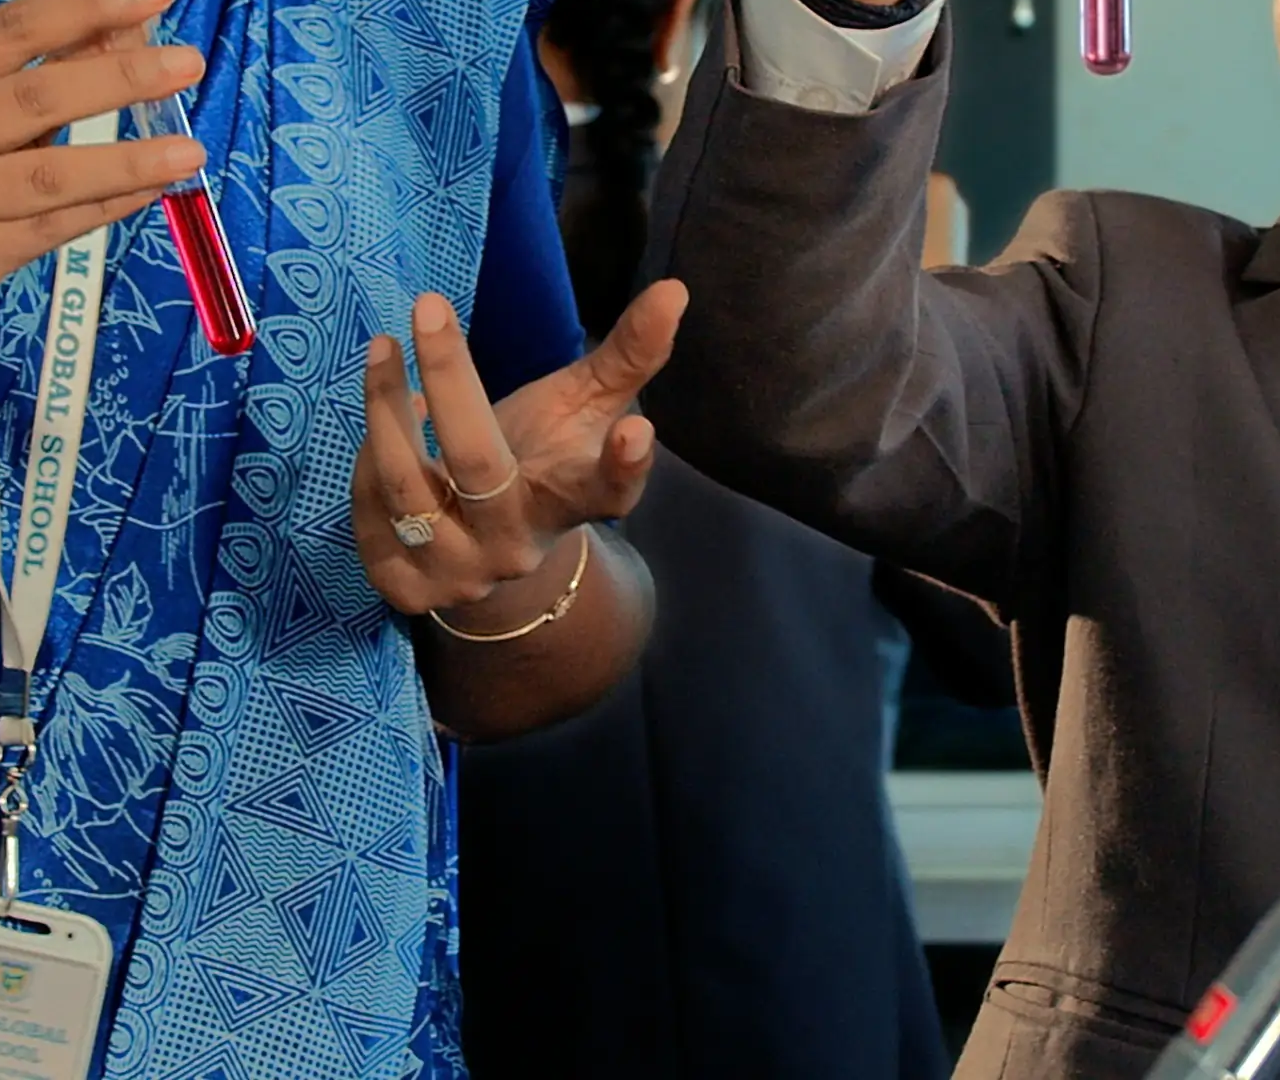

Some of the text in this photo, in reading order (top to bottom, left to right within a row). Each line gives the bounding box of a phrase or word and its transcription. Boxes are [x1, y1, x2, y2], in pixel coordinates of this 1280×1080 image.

[23, 247, 91, 577] M GLOBAL SCHOOL
